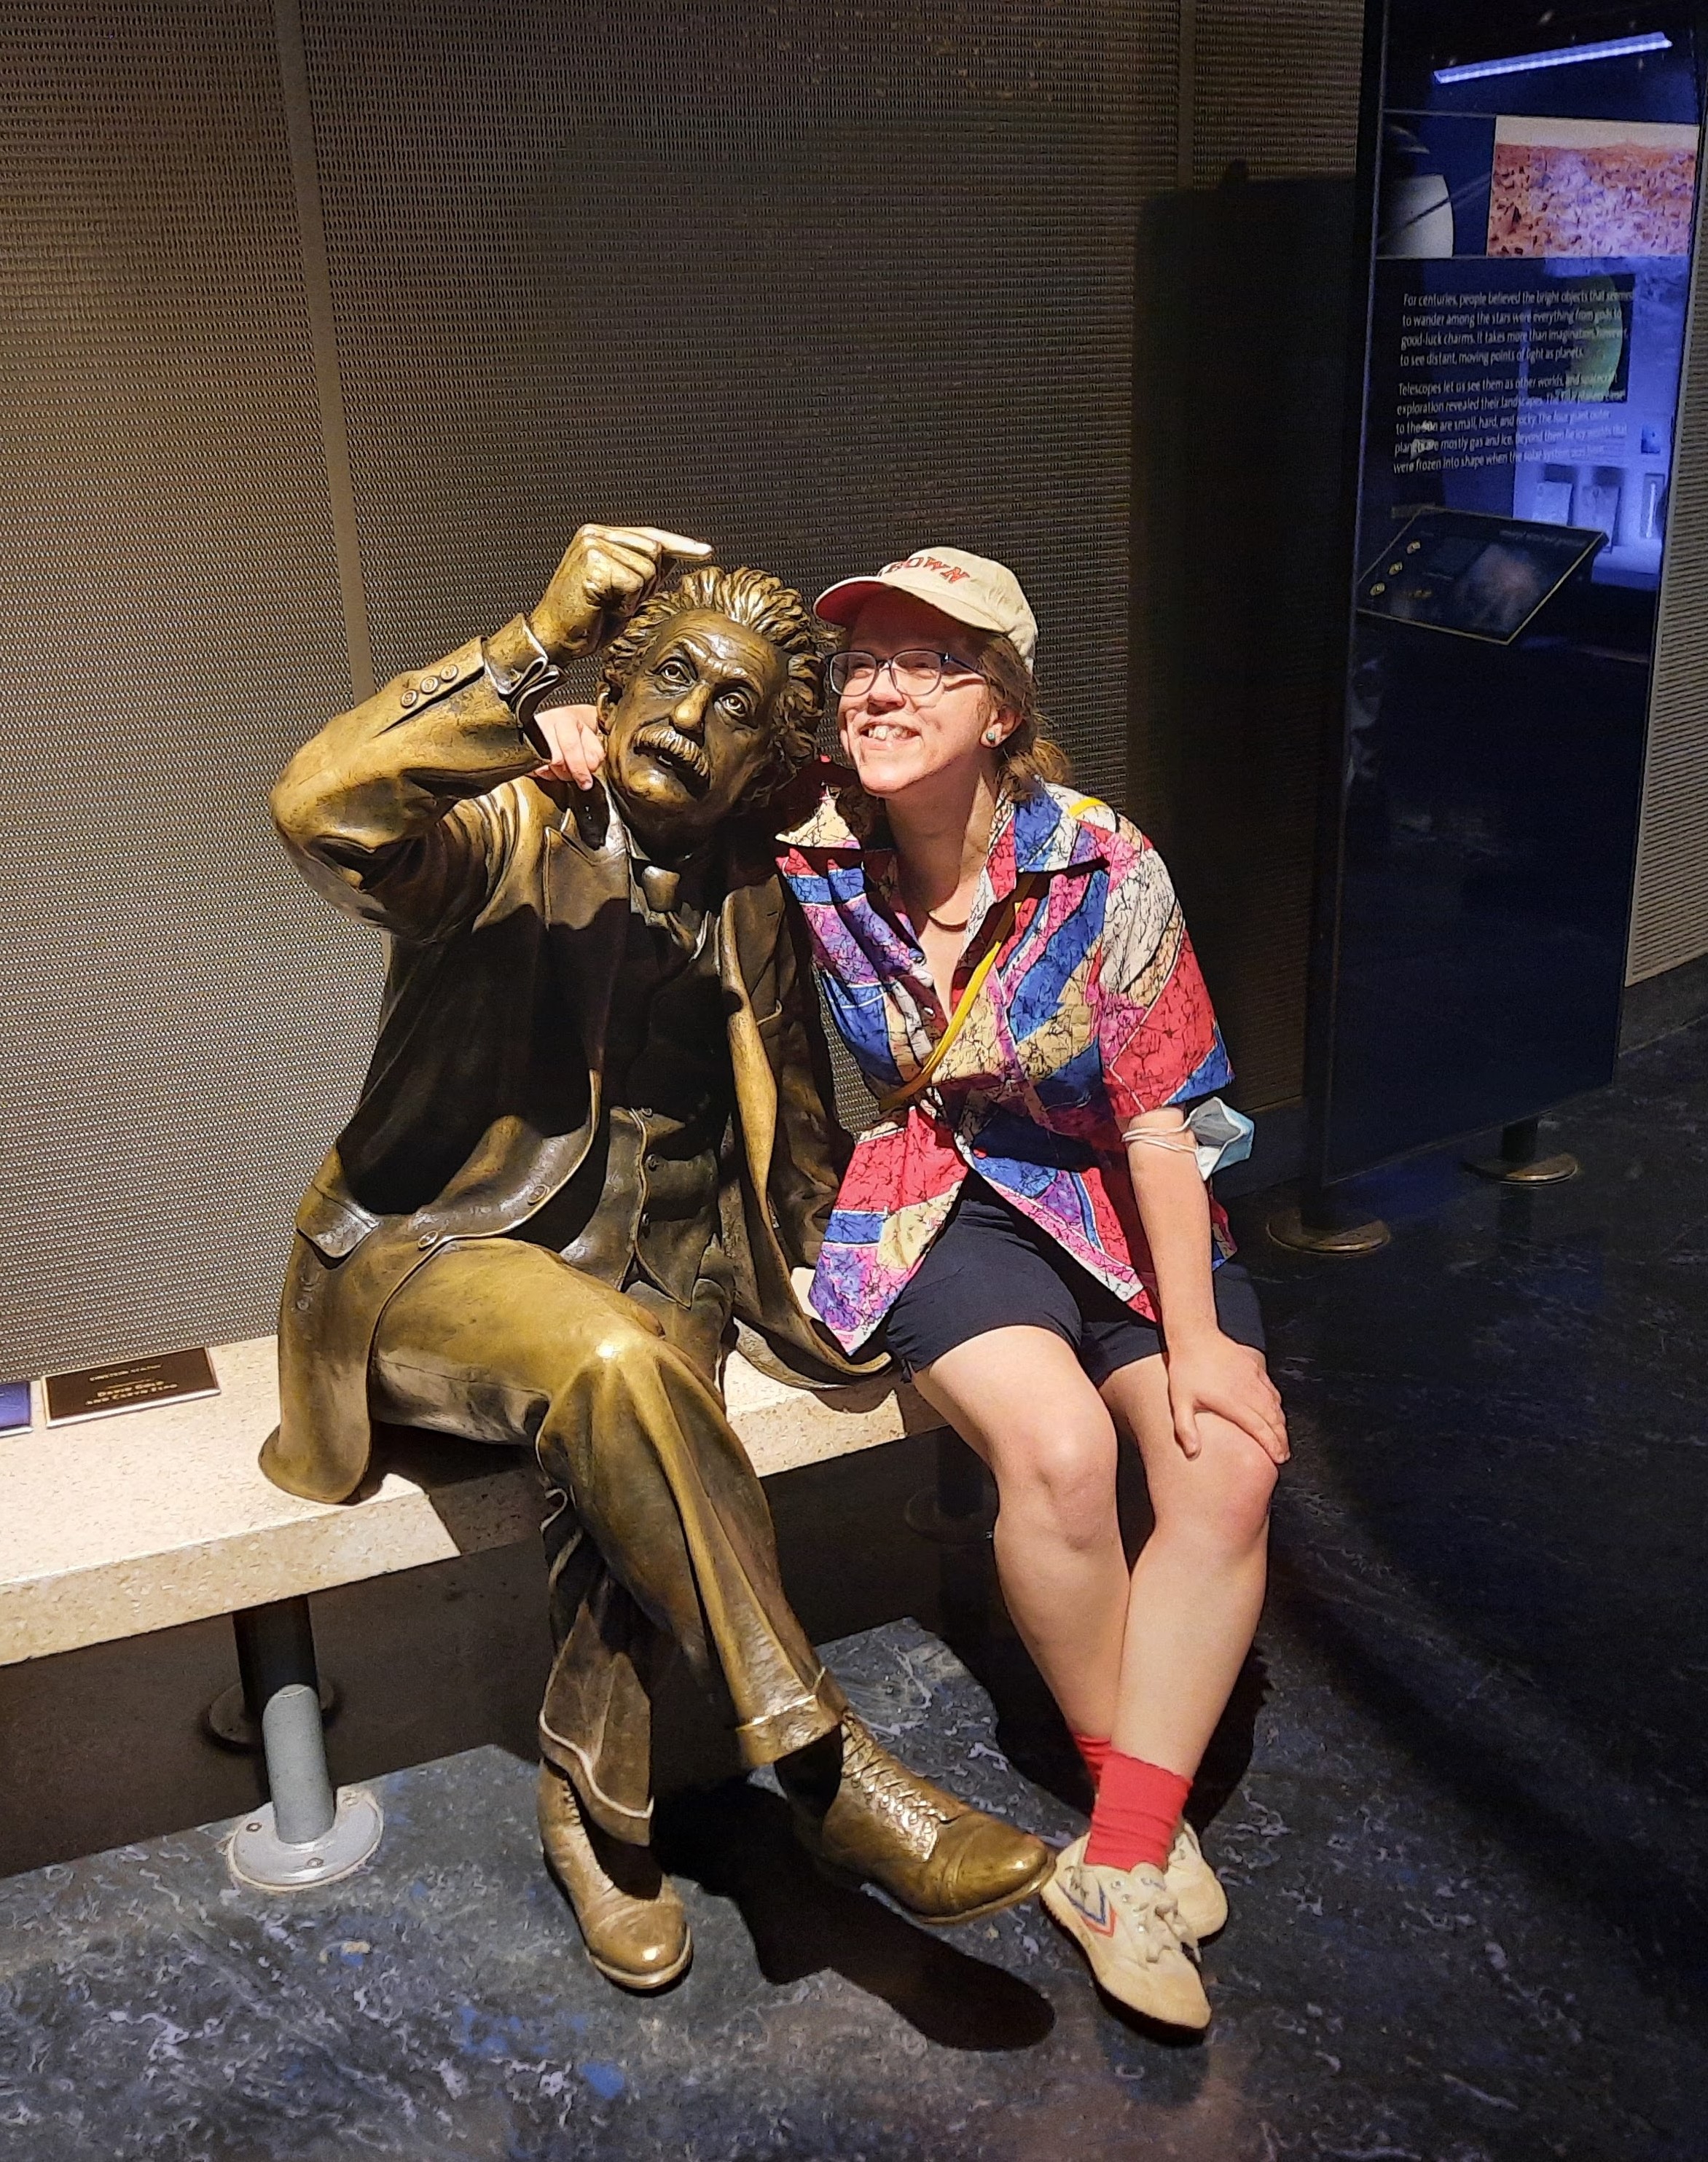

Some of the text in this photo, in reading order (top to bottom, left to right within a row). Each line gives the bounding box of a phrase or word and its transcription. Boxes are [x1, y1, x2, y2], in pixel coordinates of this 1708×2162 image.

[1403, 293, 1417, 307] For
[1460, 291, 1486, 308] people
[1488, 291, 1521, 306] believed
[1522, 290, 1535, 304] the
[1537, 290, 1559, 307] bright
[1561, 289, 1588, 306] objects
[1589, 289, 1605, 302] that
[1403, 314, 1412, 326] to
[1414, 312, 1445, 327] wander
[1446, 313, 1475, 329] among
[1477, 311, 1490, 326] the
[1492, 311, 1511, 326] stars
[1513, 311, 1532, 324] were
[1533, 308, 1574, 326] everything
[1575, 307, 1594, 322] from
[1613, 307, 1622, 320] to
[1401, 331, 1442, 350] good-luck
[1443, 331, 1475, 345] charms.
[1476, 331, 1483, 344] It
[1485, 329, 1505, 345] takes
[1507, 332, 1528, 343] more
[1529, 328, 1548, 342] than
[1401, 353, 1409, 367] to
[1411, 356, 1425, 367] see
[1426, 350, 1457, 367] distant,
[1459, 351, 1489, 367] moving
[1490, 350, 1515, 366] points
[1516, 346, 1526, 362] of
[1527, 347, 1544, 364] light
[1545, 350, 1554, 360] as
[1399, 382, 1441, 397] Telescopes
[1443, 380, 1454, 393] let
[1456, 382, 1465, 393] us
[1468, 380, 1481, 393] see
[1482, 376, 1503, 391] them
[1505, 379, 1513, 390] as
[1515, 376, 1535, 390] other
[1537, 374, 1564, 388] worlds,
[1397, 401, 1444, 418] exploration
[1446, 396, 1479, 413] revealed
[1481, 396, 1499, 411] their
[1396, 423, 1405, 436] to
[1407, 420, 1420, 434] the
[1439, 421, 1452, 433] are
[1454, 416, 1477, 431] small,
[1479, 415, 1498, 430] hard,
[1500, 415, 1514, 428] and
[1441, 435, 1468, 453] mostly
[1470, 437, 1484, 453] gas
[1484, 433, 1500, 446] and
[1501, 433, 1513, 446] ice.
[1393, 462, 1414, 474] were
[1415, 457, 1441, 471] frozen
[1443, 455, 1460, 470] into
[1461, 454, 1484, 470] shape
[1486, 452, 1508, 466] when
